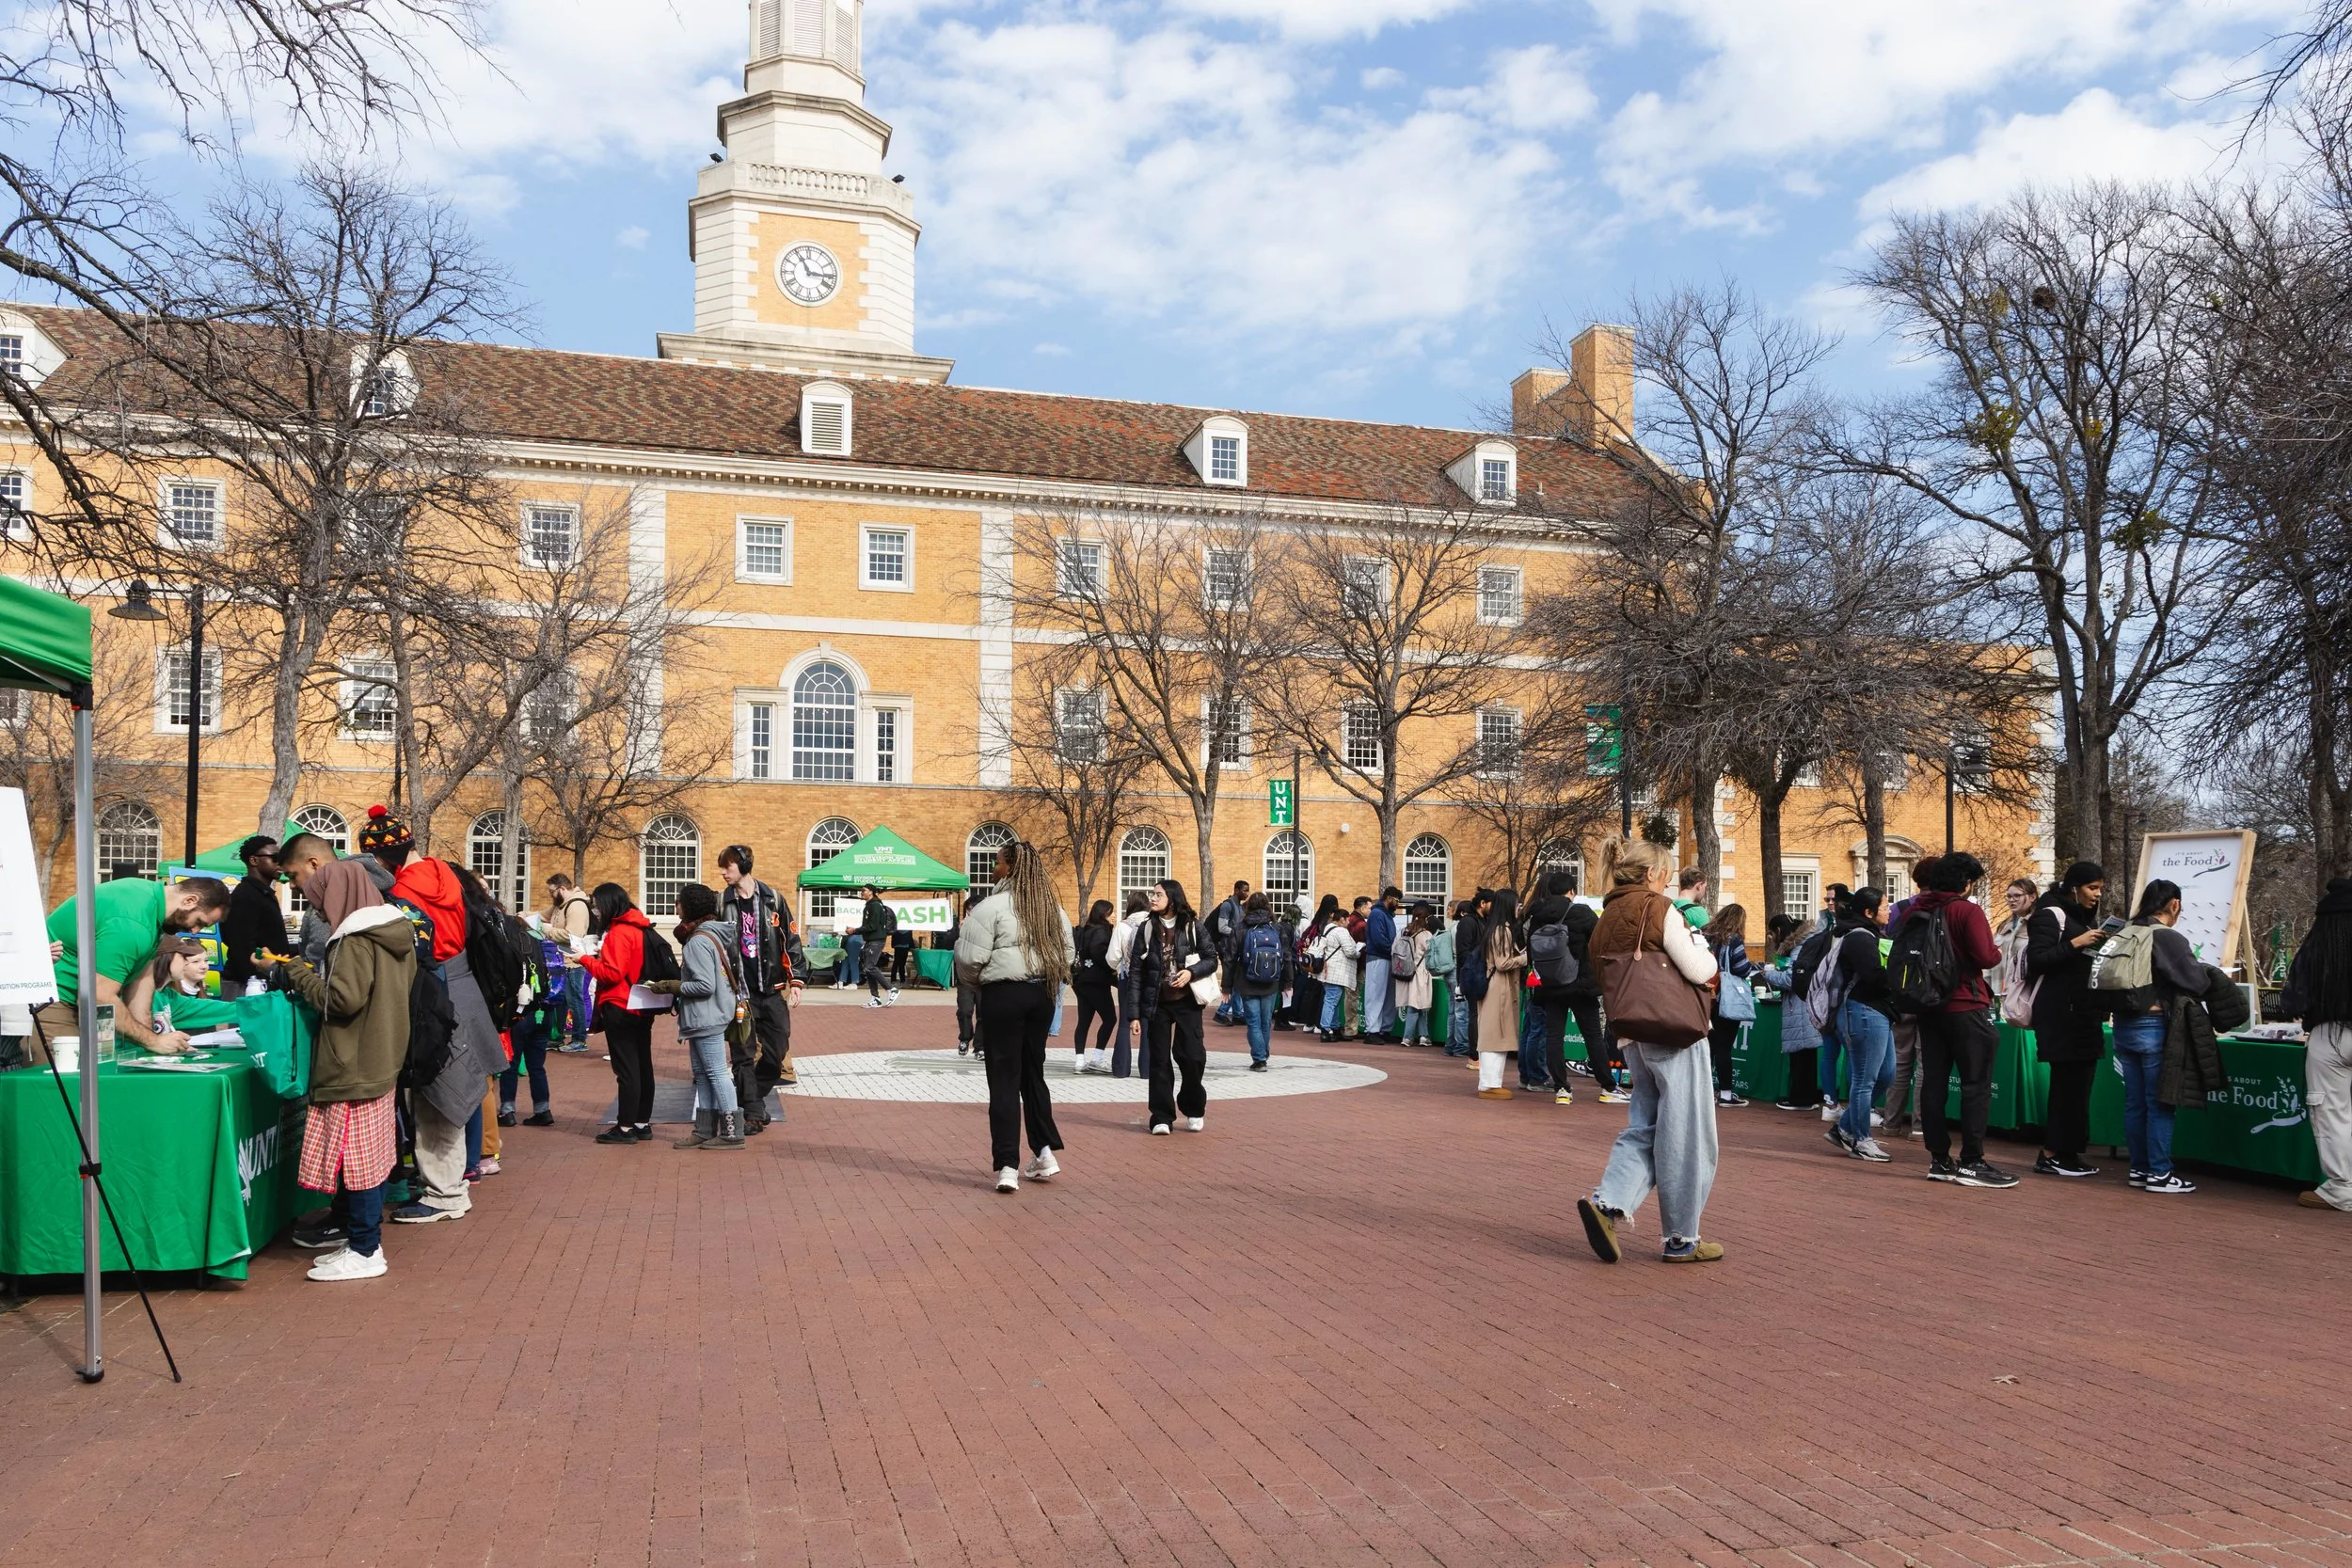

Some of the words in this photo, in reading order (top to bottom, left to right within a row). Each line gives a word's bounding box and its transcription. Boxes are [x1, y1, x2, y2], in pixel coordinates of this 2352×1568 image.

[1274, 782, 1288, 824] UNT
[2163, 857, 2181, 866] the
[2184, 856, 2213, 866] Food
[2091, 940, 2117, 990] adidas
[21, 981, 53, 990] PROGRAMS
[2234, 1077, 2262, 1085] ABOUT
[2233, 1086, 2279, 1110] Food
[246, 1125, 278, 1181] UNT
